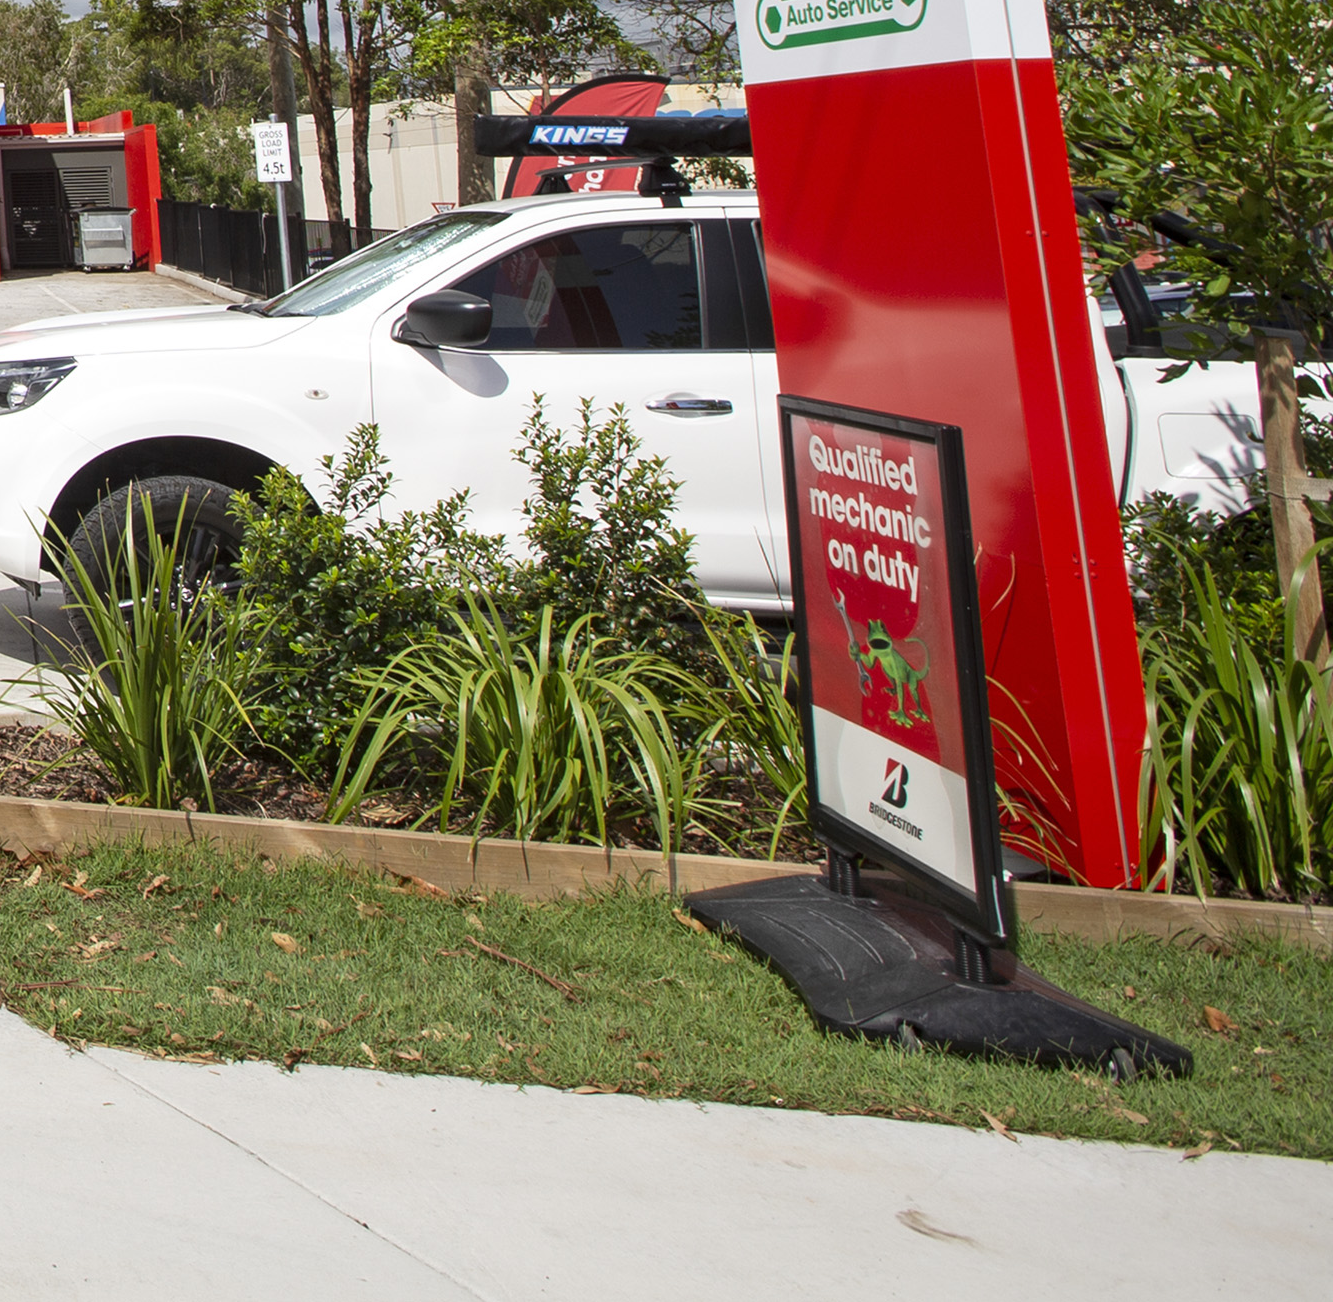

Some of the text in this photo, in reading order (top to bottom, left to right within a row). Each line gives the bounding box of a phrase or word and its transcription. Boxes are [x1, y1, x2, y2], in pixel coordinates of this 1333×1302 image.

[786, 3, 824, 28] Auto
[259, 130, 283, 139] GROSS
[262, 139, 282, 147] LOAD
[531, 126, 629, 145] KINGS
[263, 148, 282, 157] LIMIT
[263, 162, 285, 174] 4.5t
[809, 434, 918, 496] Qualified
[809, 487, 932, 548] mechanic
[828, 538, 919, 603] on duty
[869, 801, 923, 841] BRIDGESTONE
